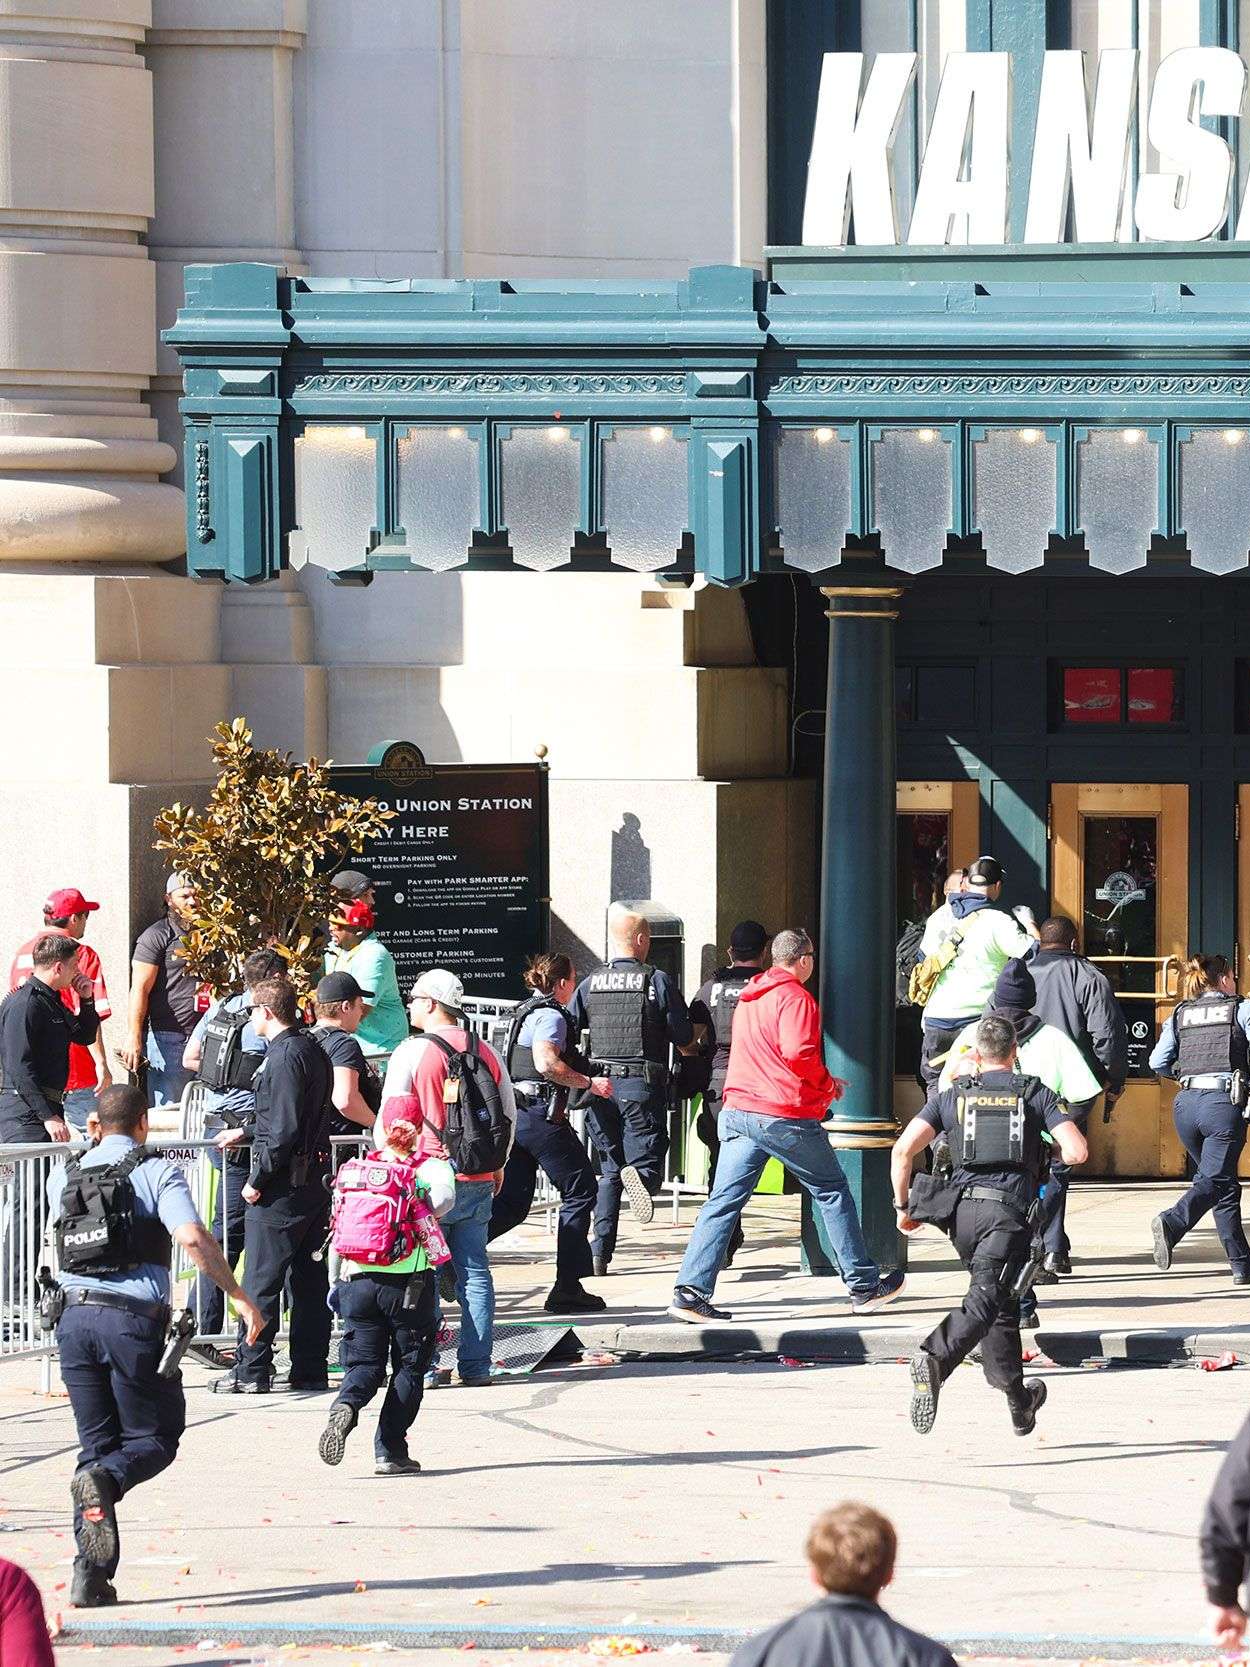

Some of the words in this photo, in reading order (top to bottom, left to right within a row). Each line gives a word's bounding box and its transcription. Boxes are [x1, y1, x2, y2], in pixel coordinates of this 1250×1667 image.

[396, 799, 451, 812] UNION
[458, 798, 533, 811] STATION
[402, 825, 449, 838] HERE
[469, 876, 509, 884] SMARTER
[437, 928, 460, 936] TERM
[462, 927, 499, 935] PARKING
[590, 973, 624, 990] POLICE
[625, 973, 643, 989] K-9
[1183, 1005, 1229, 1026] POLICE
[968, 1096, 1016, 1106] POLICE
[64, 1226, 108, 1247] POLICE
